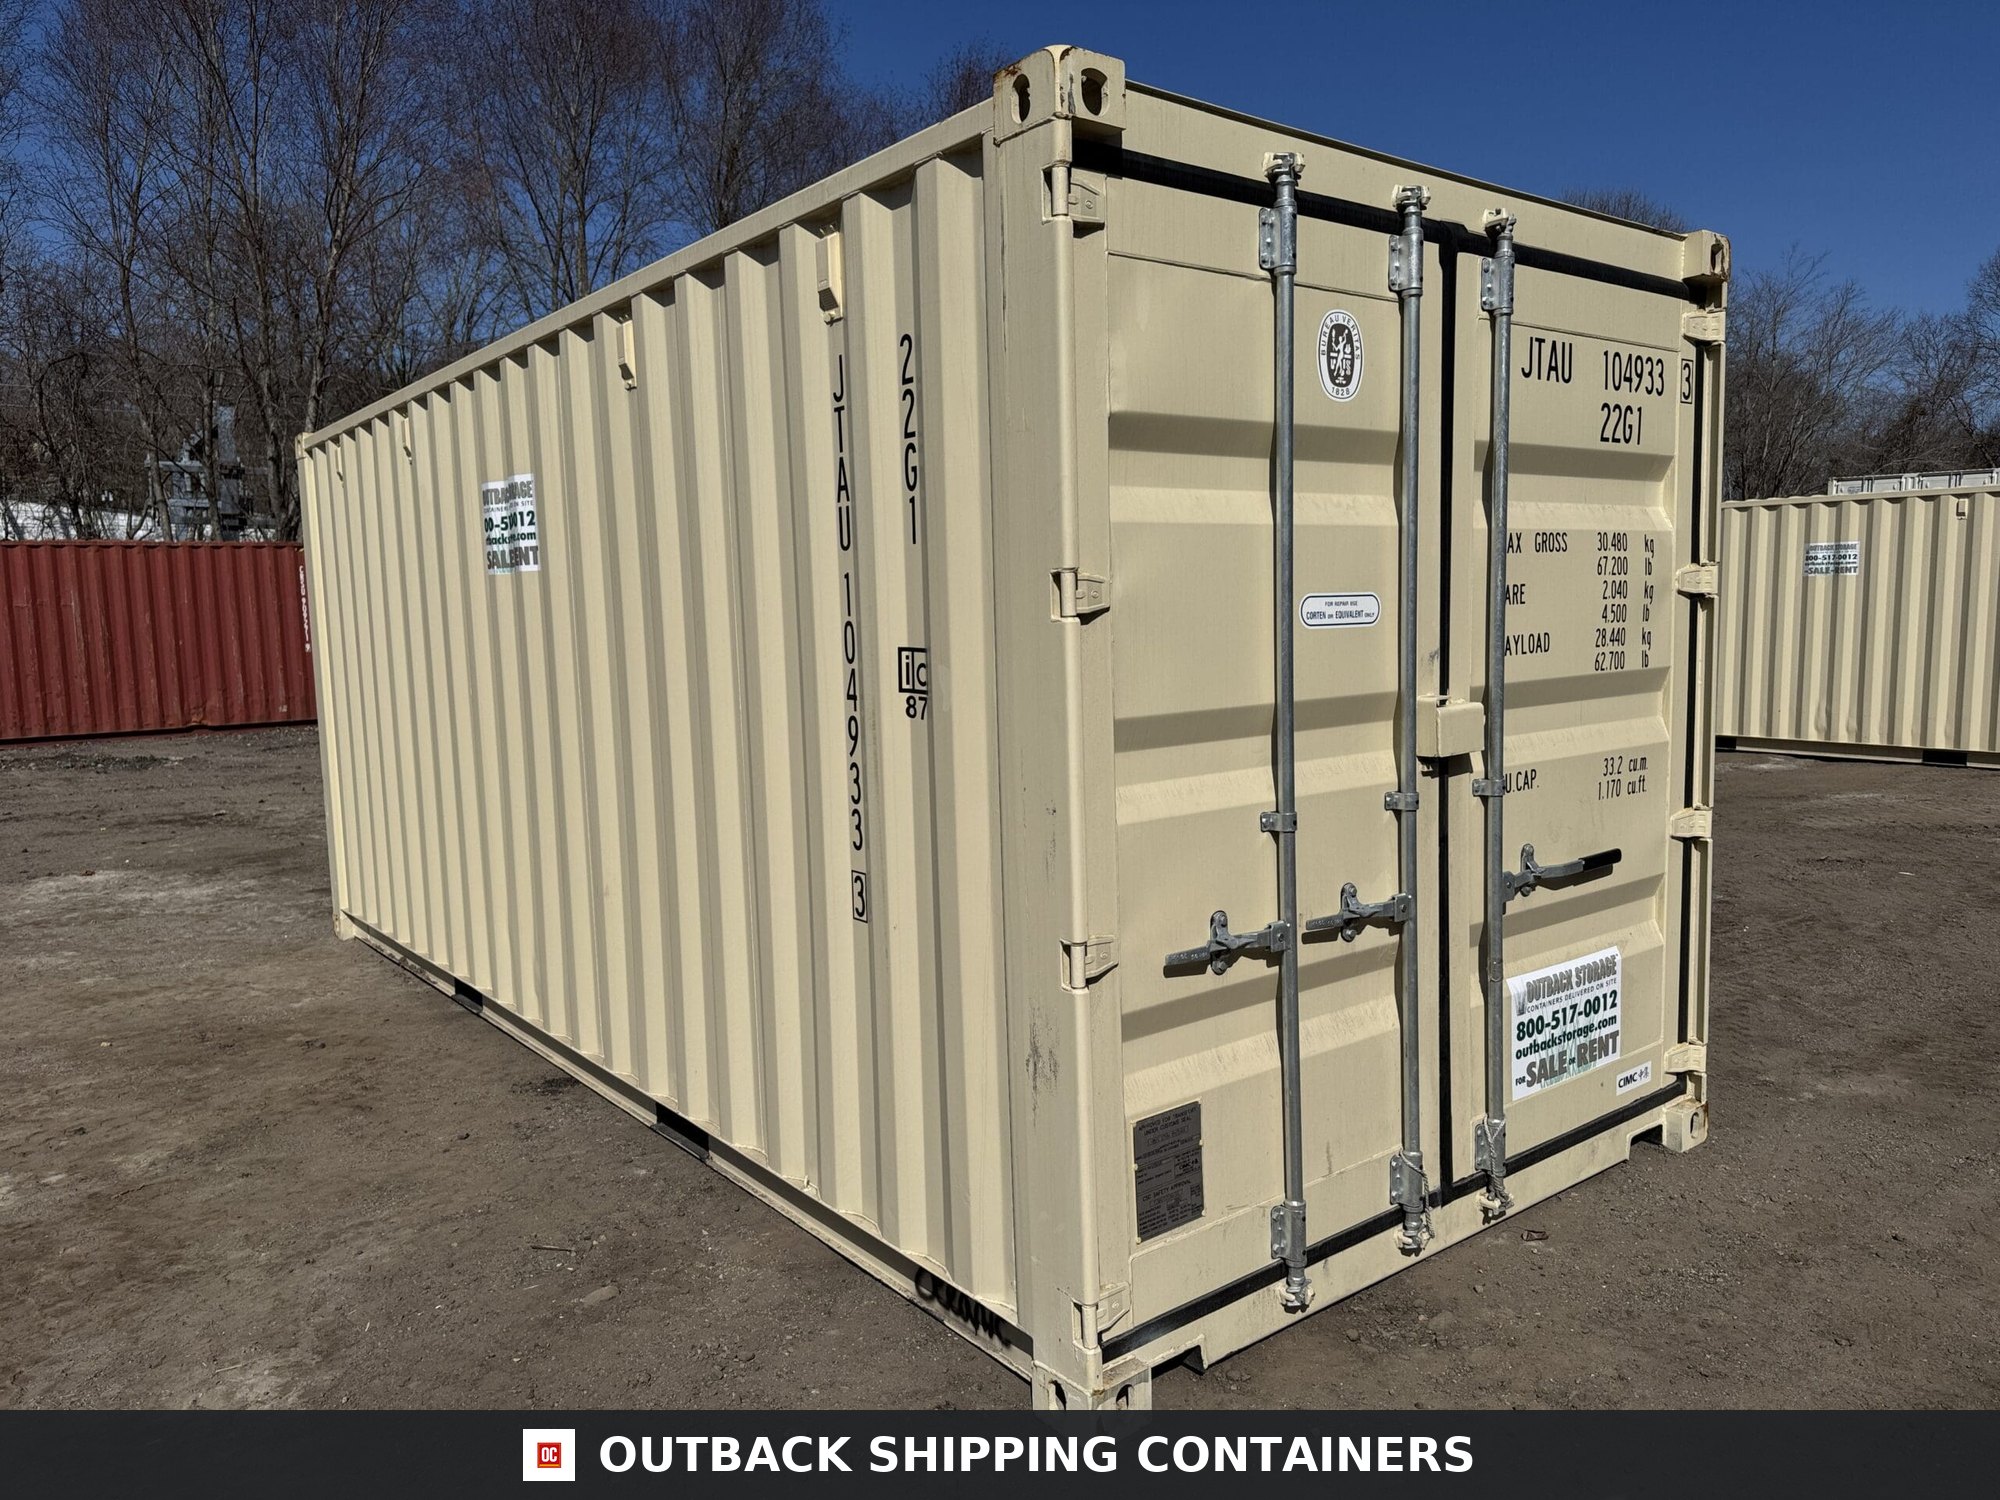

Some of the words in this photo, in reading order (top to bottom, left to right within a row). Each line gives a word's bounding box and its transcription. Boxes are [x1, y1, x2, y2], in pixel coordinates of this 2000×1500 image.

[1320, 314, 1340, 356] BUREAU
[1342, 316, 1361, 360] VERITAS
[1521, 336, 1573, 384] JTAU
[1603, 350, 1664, 396] 104933
[1681, 361, 1692, 402] 3
[1332, 387, 1351, 396] 1828
[1600, 402, 1642, 445] 22G1
[900, 334, 918, 545] 22G1
[513, 546, 539, 566] ENT
[1534, 532, 1568, 552] GROSS
[1597, 532, 1628, 552] 30.480
[1644, 534, 1655, 558] kg
[1597, 556, 1628, 576] 67.200
[1644, 557, 1652, 576] lb
[1505, 584, 1526, 606] ARE
[1602, 580, 1628, 600] 2.040
[1644, 581, 1654, 605] kg
[1306, 611, 1326, 620] CORTEN
[1335, 610, 1364, 620] EQUIVALENT
[1602, 604, 1627, 624] 4.500
[1642, 604, 1650, 622] lb
[833, 354, 851, 551] JTAU
[844, 572, 862, 851] 104933
[853, 873, 866, 919] 3
[1504, 632, 1550, 656] AYLOAD
[1595, 628, 1626, 648] 28.440
[1641, 628, 1652, 650] kg
[1594, 650, 1626, 672] 62.700
[1641, 650, 1650, 668] lb
[905, 694, 928, 720] 87
[1504, 768, 1540, 794] U.CAP.
[1603, 756, 1623, 777] 33.2
[1598, 778, 1622, 801] 1.170
[1526, 968, 1574, 1004] OUTBACK
[1574, 956, 1617, 988] STORAGE
[1526, 996, 1563, 1013] CONTAINERS
[1564, 986, 1595, 1001] DELIVERED
[1596, 982, 1604, 991] ON
[1606, 978, 1617, 987] SITE
[1516, 989, 1618, 1042] 800-517-0012
[1516, 1014, 1617, 1060] outbackstorage.com
[1516, 1076, 1526, 1086] FOR
[1526, 1050, 1568, 1088] SALE
[1568, 1058, 1576, 1066] OR
[1577, 1030, 1620, 1068] RENT
[1618, 1072, 1638, 1088] CIMC
